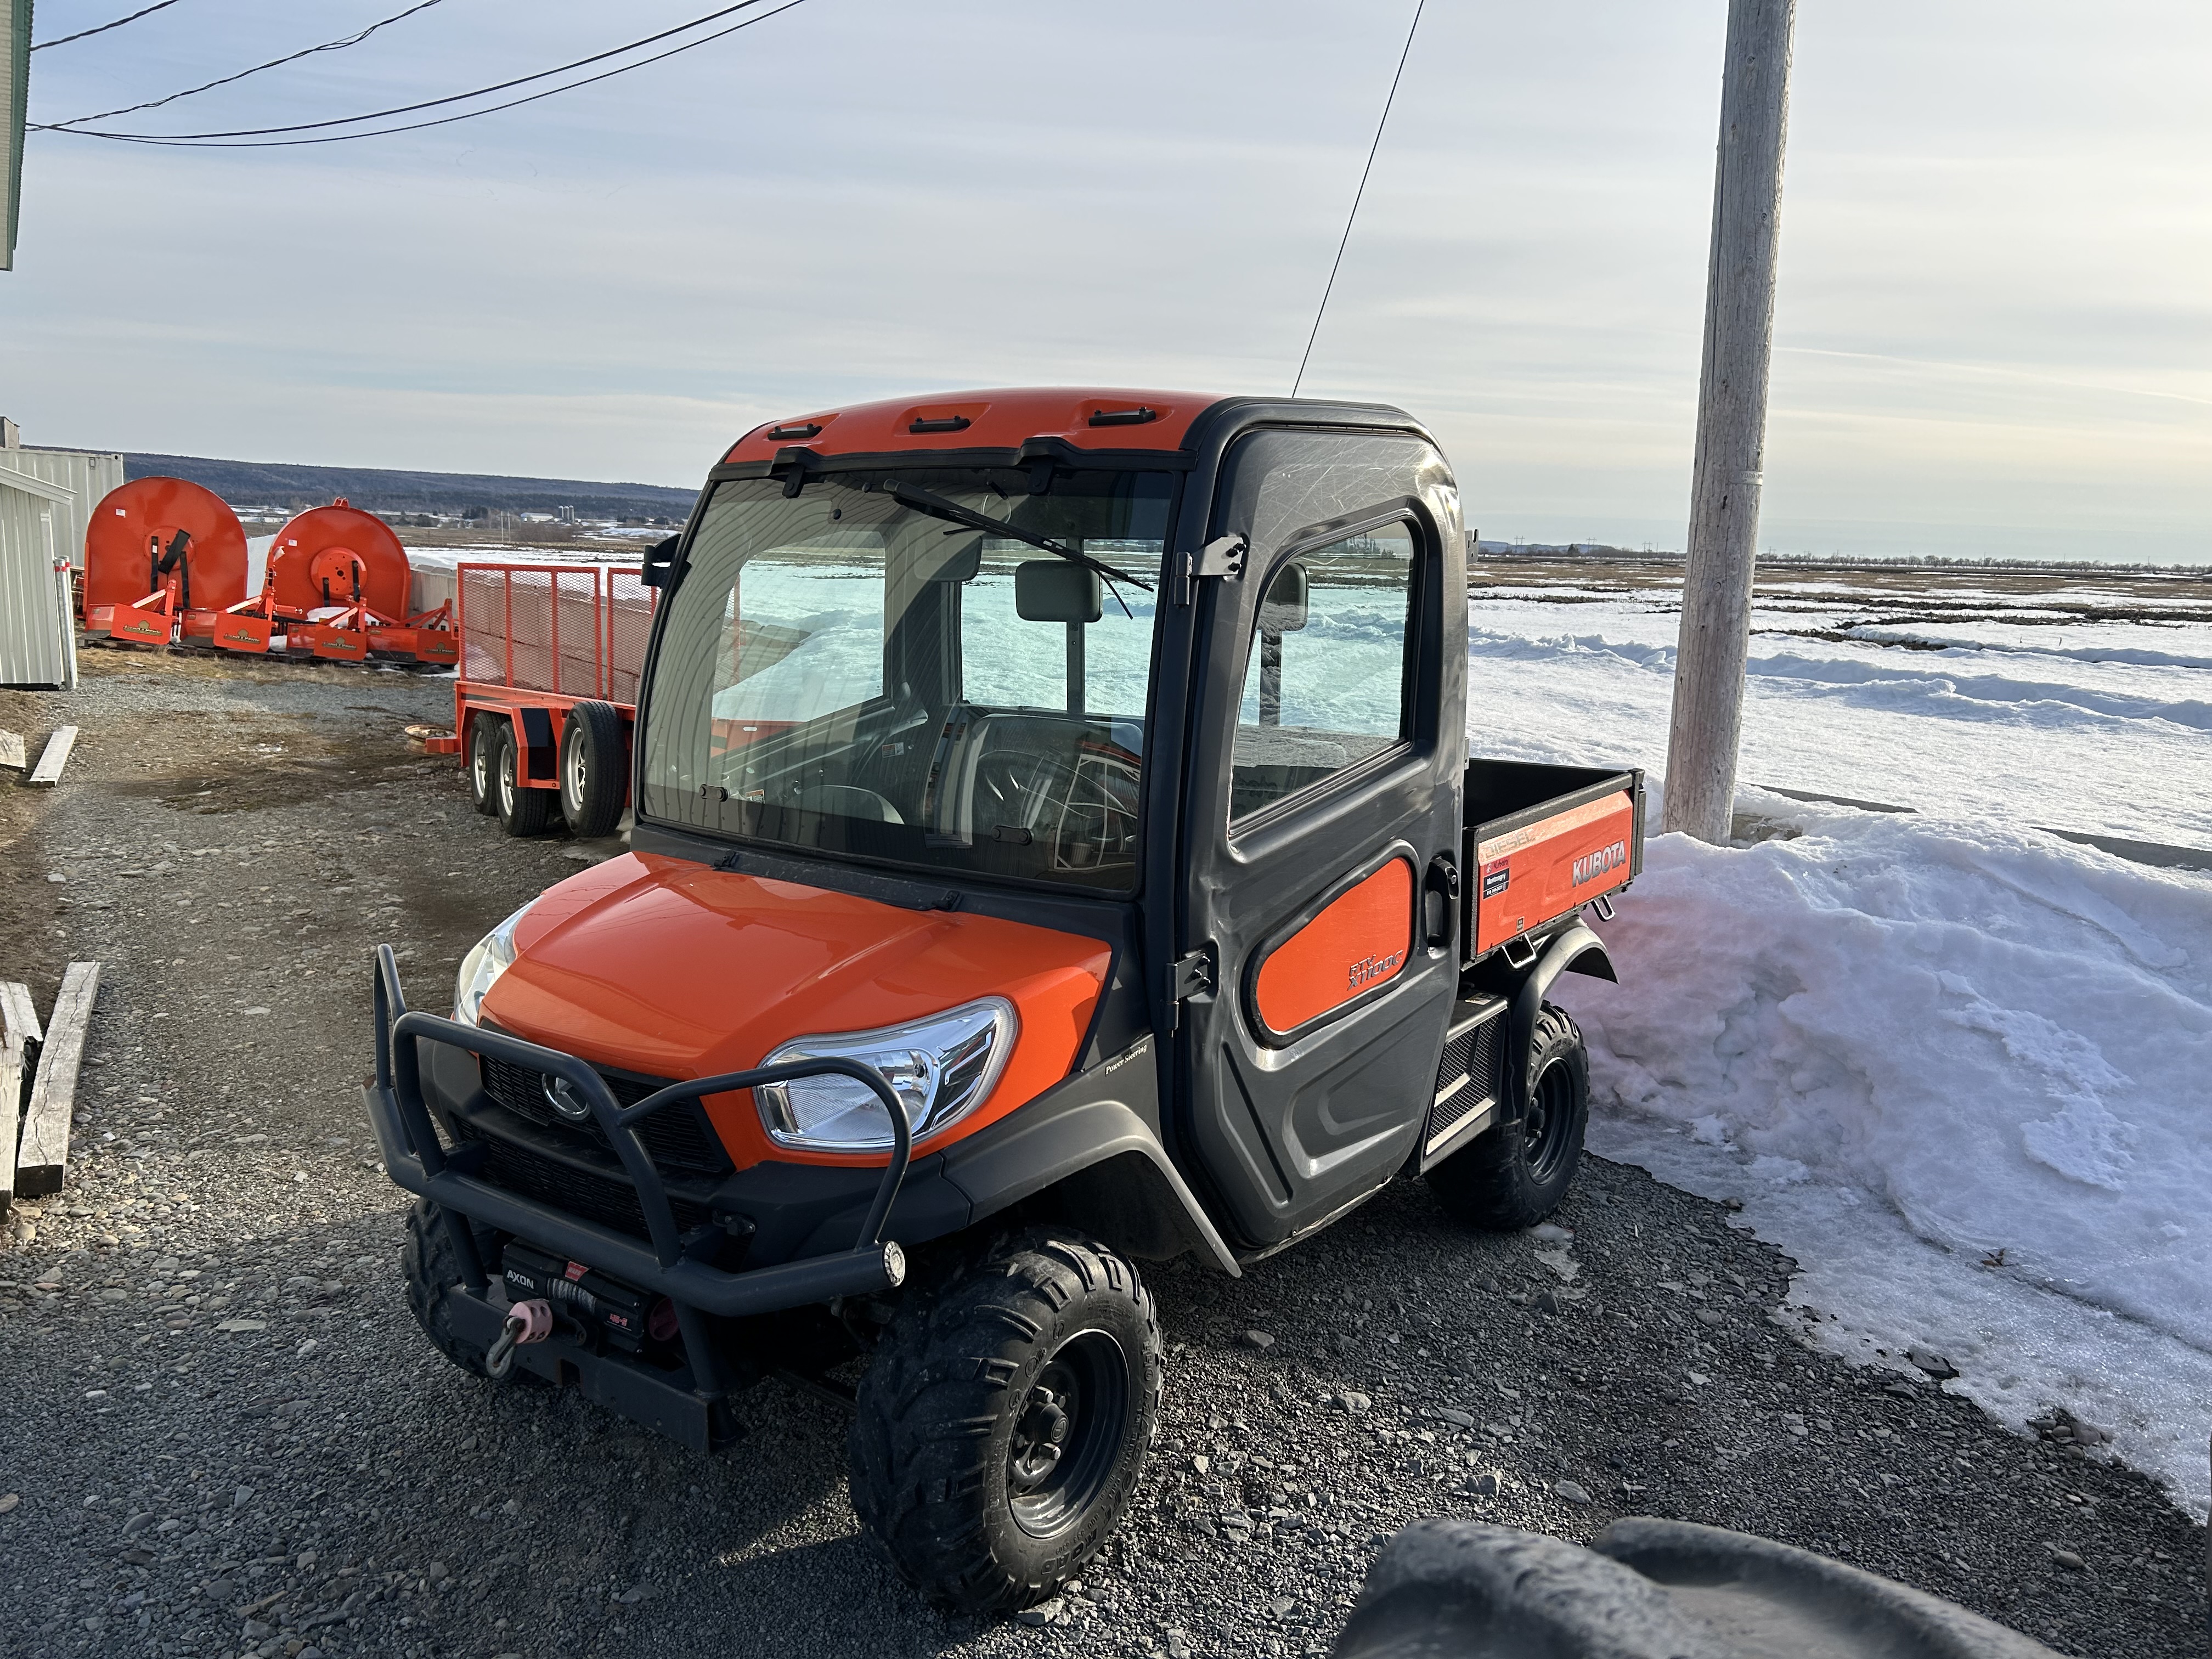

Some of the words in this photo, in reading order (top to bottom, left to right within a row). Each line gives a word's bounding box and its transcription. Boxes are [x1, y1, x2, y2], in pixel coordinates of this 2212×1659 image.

[1483, 831, 1536, 859] DIESEL
[1572, 839, 1626, 888] KUBOTA
[1347, 949, 1403, 991] X1100C
[1349, 953, 1377, 977] RTV
[1104, 1058, 1125, 1077] Power
[1124, 1044, 1147, 1063] Steering
[507, 1269, 534, 1290] AXON
[1041, 1528, 1097, 1576] ROAD
